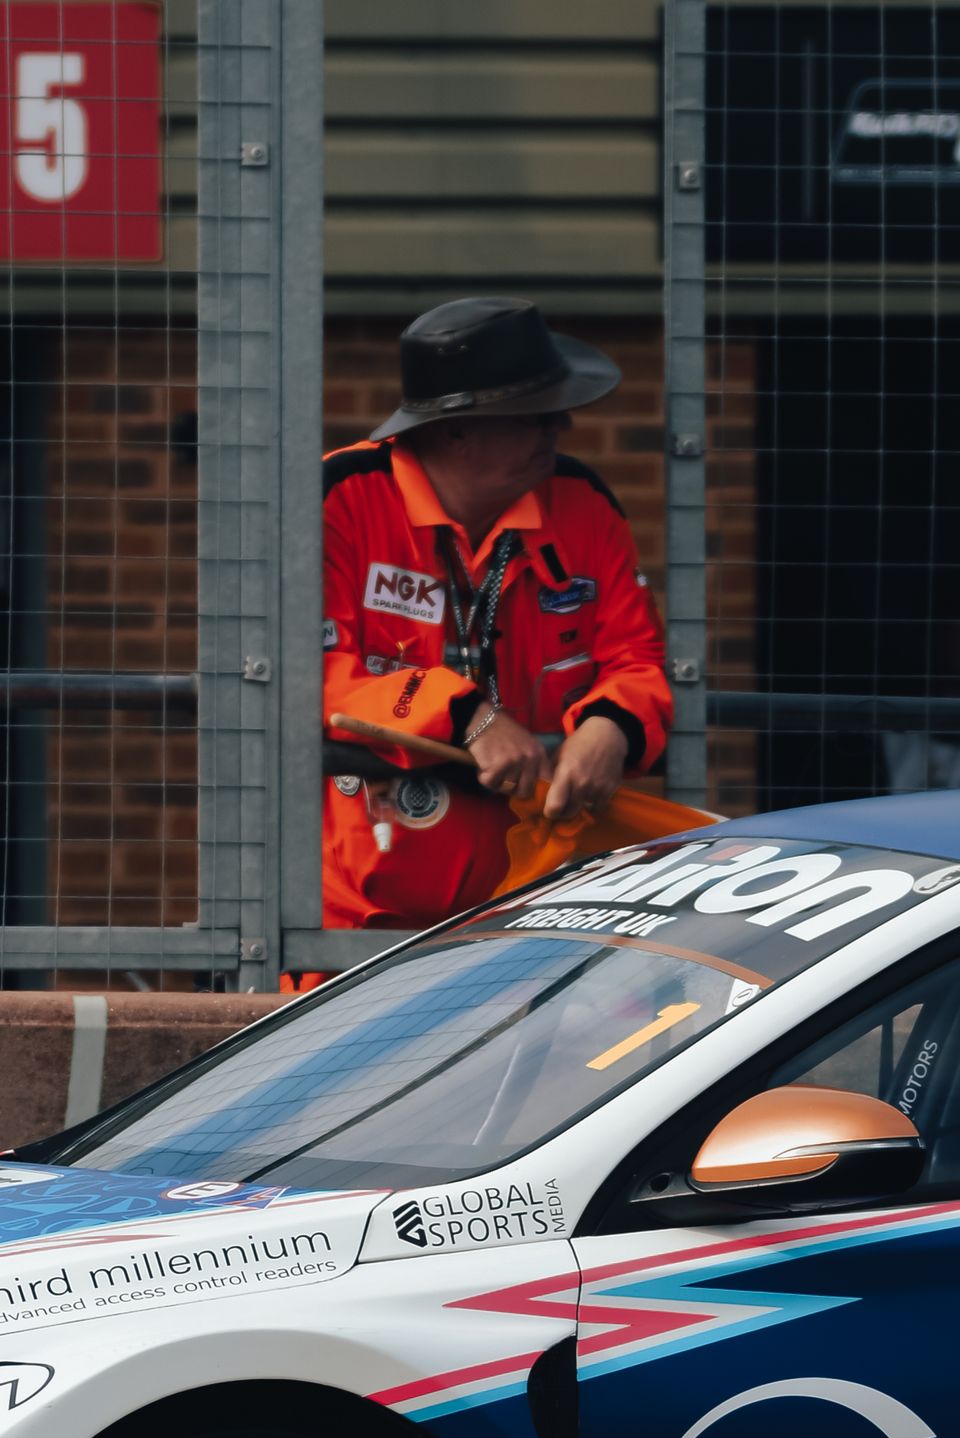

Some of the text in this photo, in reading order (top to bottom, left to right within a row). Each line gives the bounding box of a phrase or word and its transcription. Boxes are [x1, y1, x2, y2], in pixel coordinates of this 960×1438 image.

[16, 53, 87, 202] 5
[374, 570, 440, 607] NGK
[504, 907, 679, 937] FREIGHT UK
[586, 1002, 701, 1071] 1
[898, 1039, 938, 1115] MOTORS
[423, 1181, 543, 1218] GLOBAL
[548, 1177, 567, 1233] MEDIA
[432, 1208, 549, 1247] SPORTS
[89, 1230, 332, 1290] millennium
[95, 1286, 166, 1307] access
[173, 1270, 248, 1295] control
[255, 1257, 337, 1281] readers
